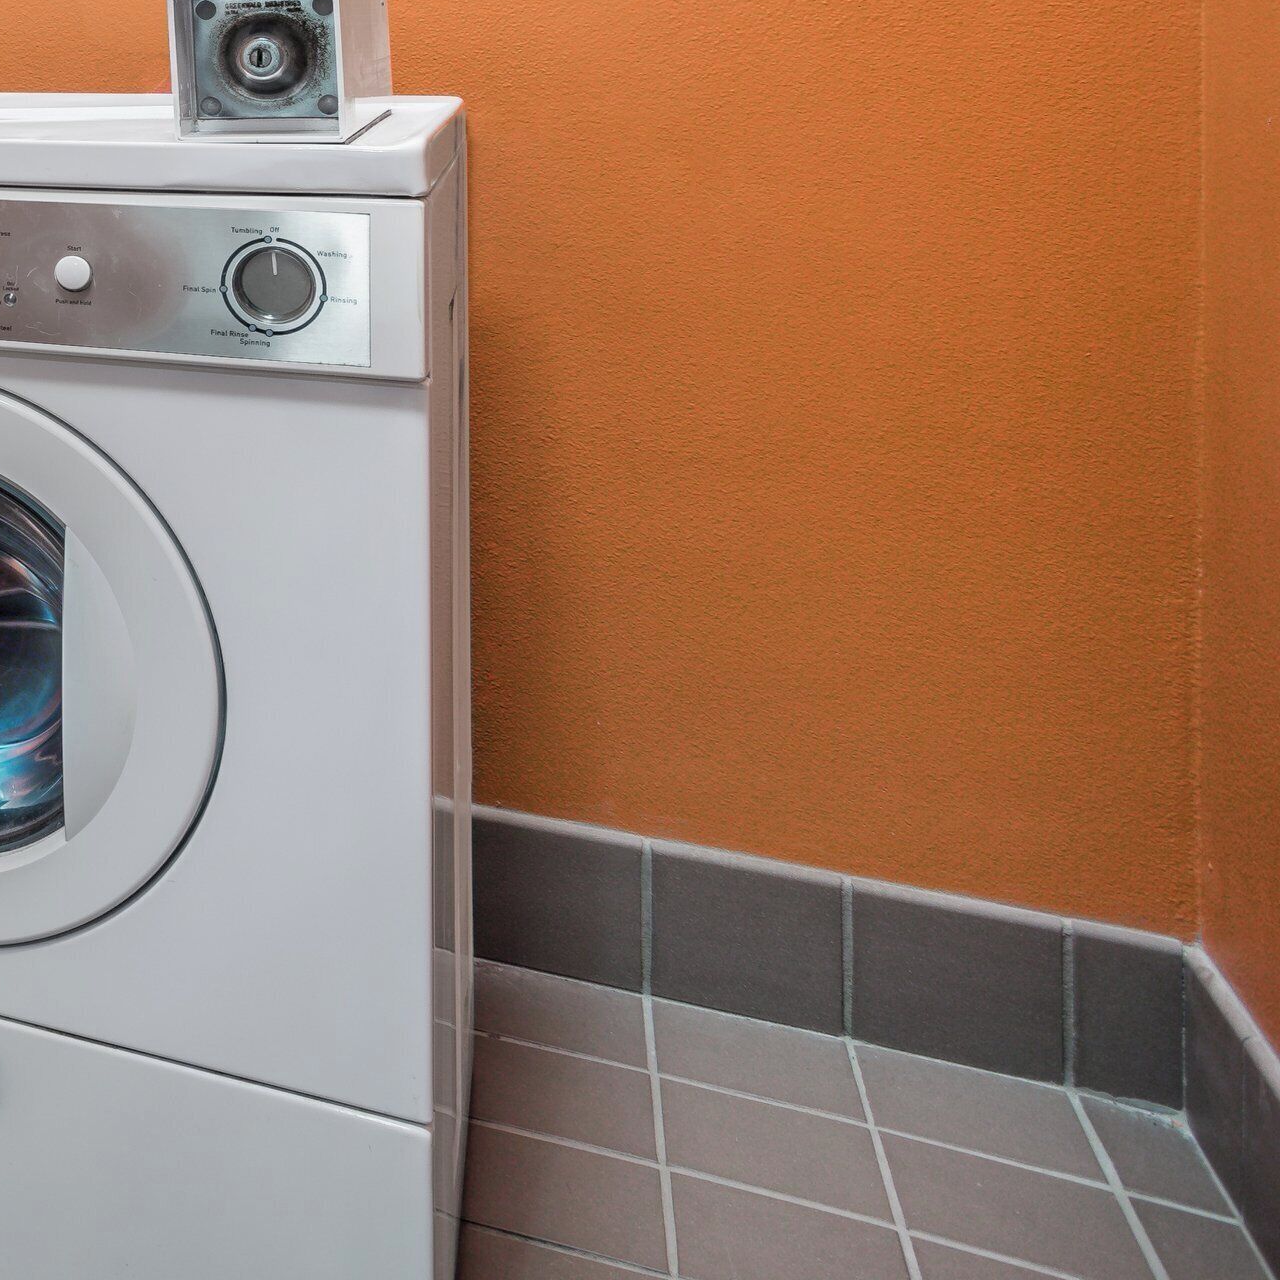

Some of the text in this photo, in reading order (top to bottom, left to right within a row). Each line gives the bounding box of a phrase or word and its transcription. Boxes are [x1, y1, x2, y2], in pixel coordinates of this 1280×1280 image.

[231, 227, 263, 235] Tumbling
[317, 250, 348, 259] Washing
[183, 285, 200, 293] Final
[330, 296, 358, 305] Rinsing
[210, 329, 228, 337] Final
[239, 338, 271, 347] Spinning
